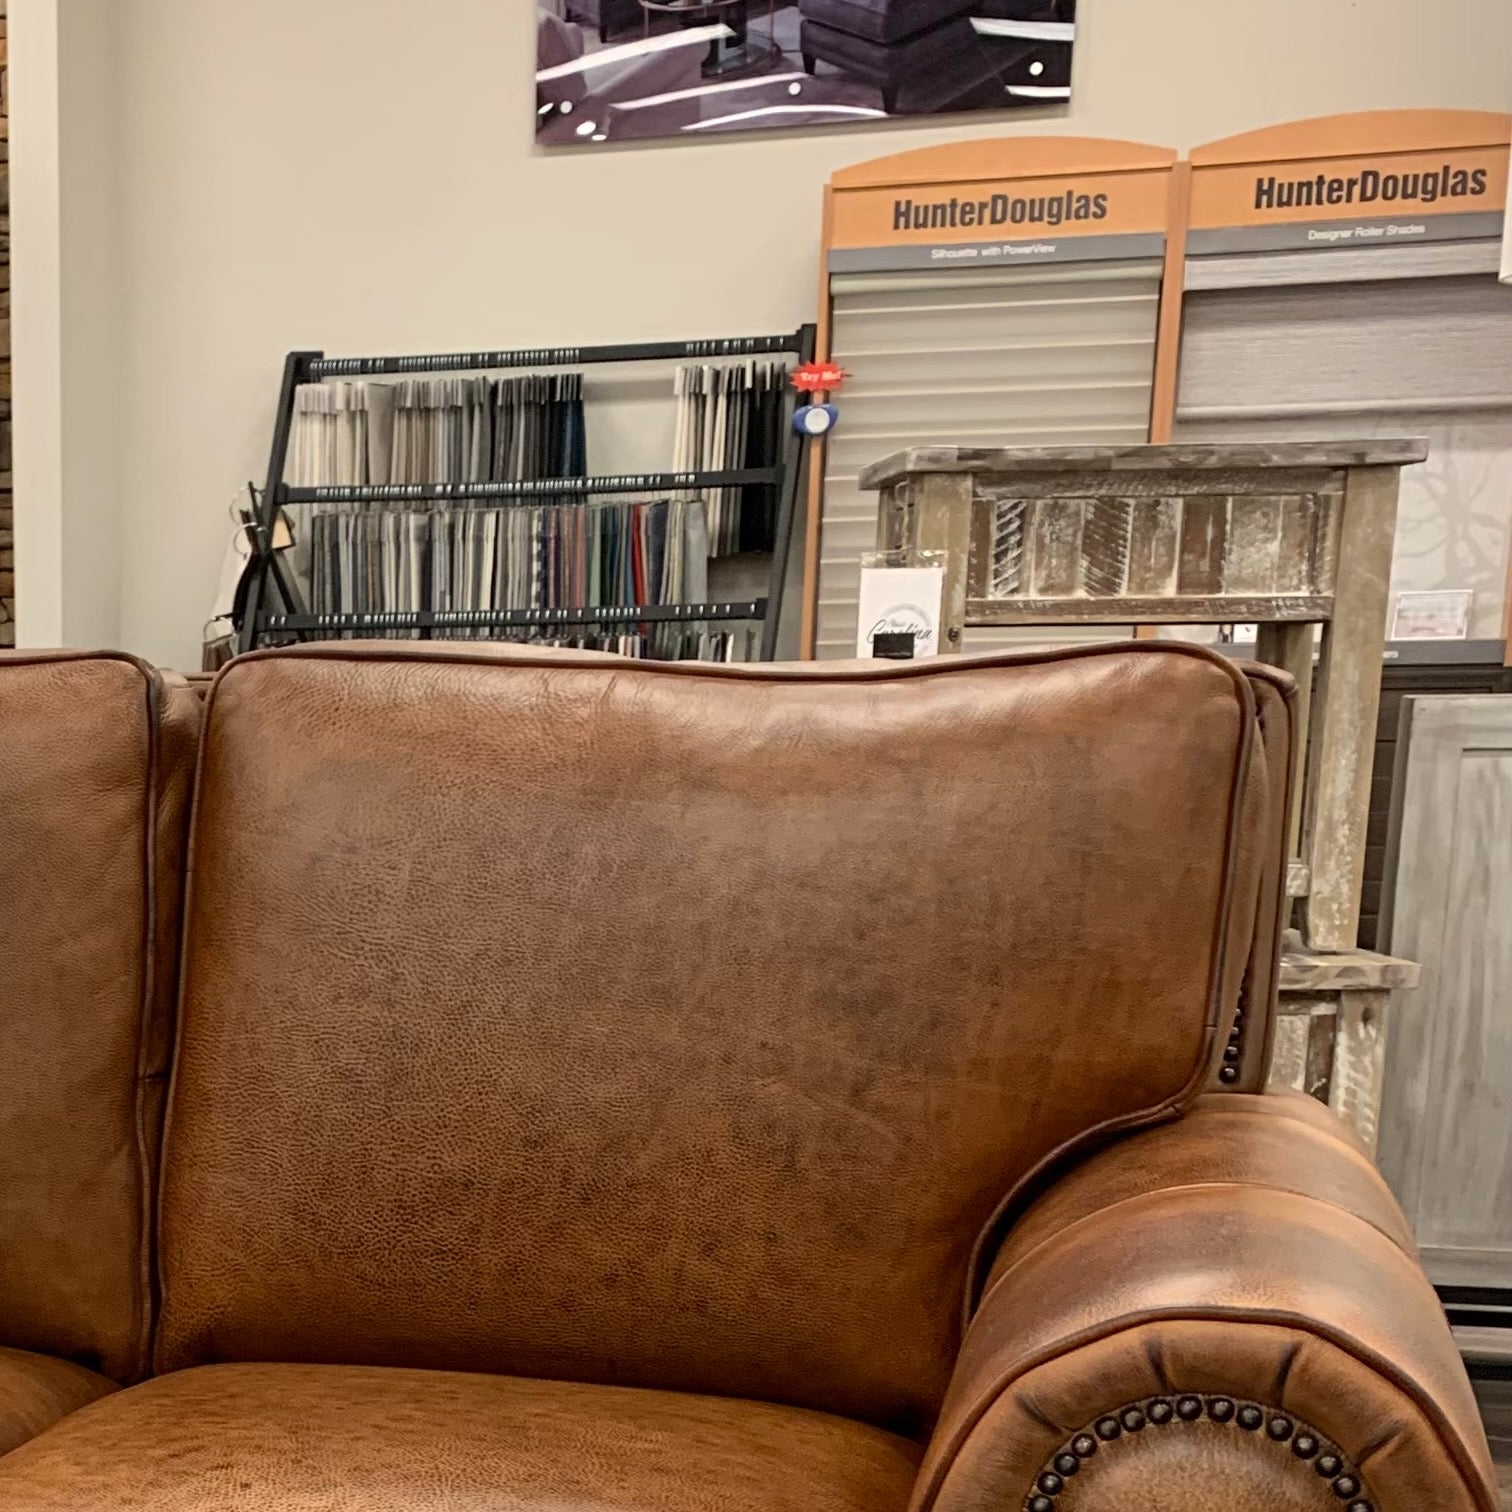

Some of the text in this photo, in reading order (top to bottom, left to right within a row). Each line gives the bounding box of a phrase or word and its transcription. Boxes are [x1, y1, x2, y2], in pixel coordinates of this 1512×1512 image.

[1254, 165, 1487, 210] HunterDouglas
[892, 189, 1108, 231] HunterDouglas
[1308, 224, 1426, 242] Designer Roller Shades
[930, 243, 1056, 259] Silhouette with PowerView
